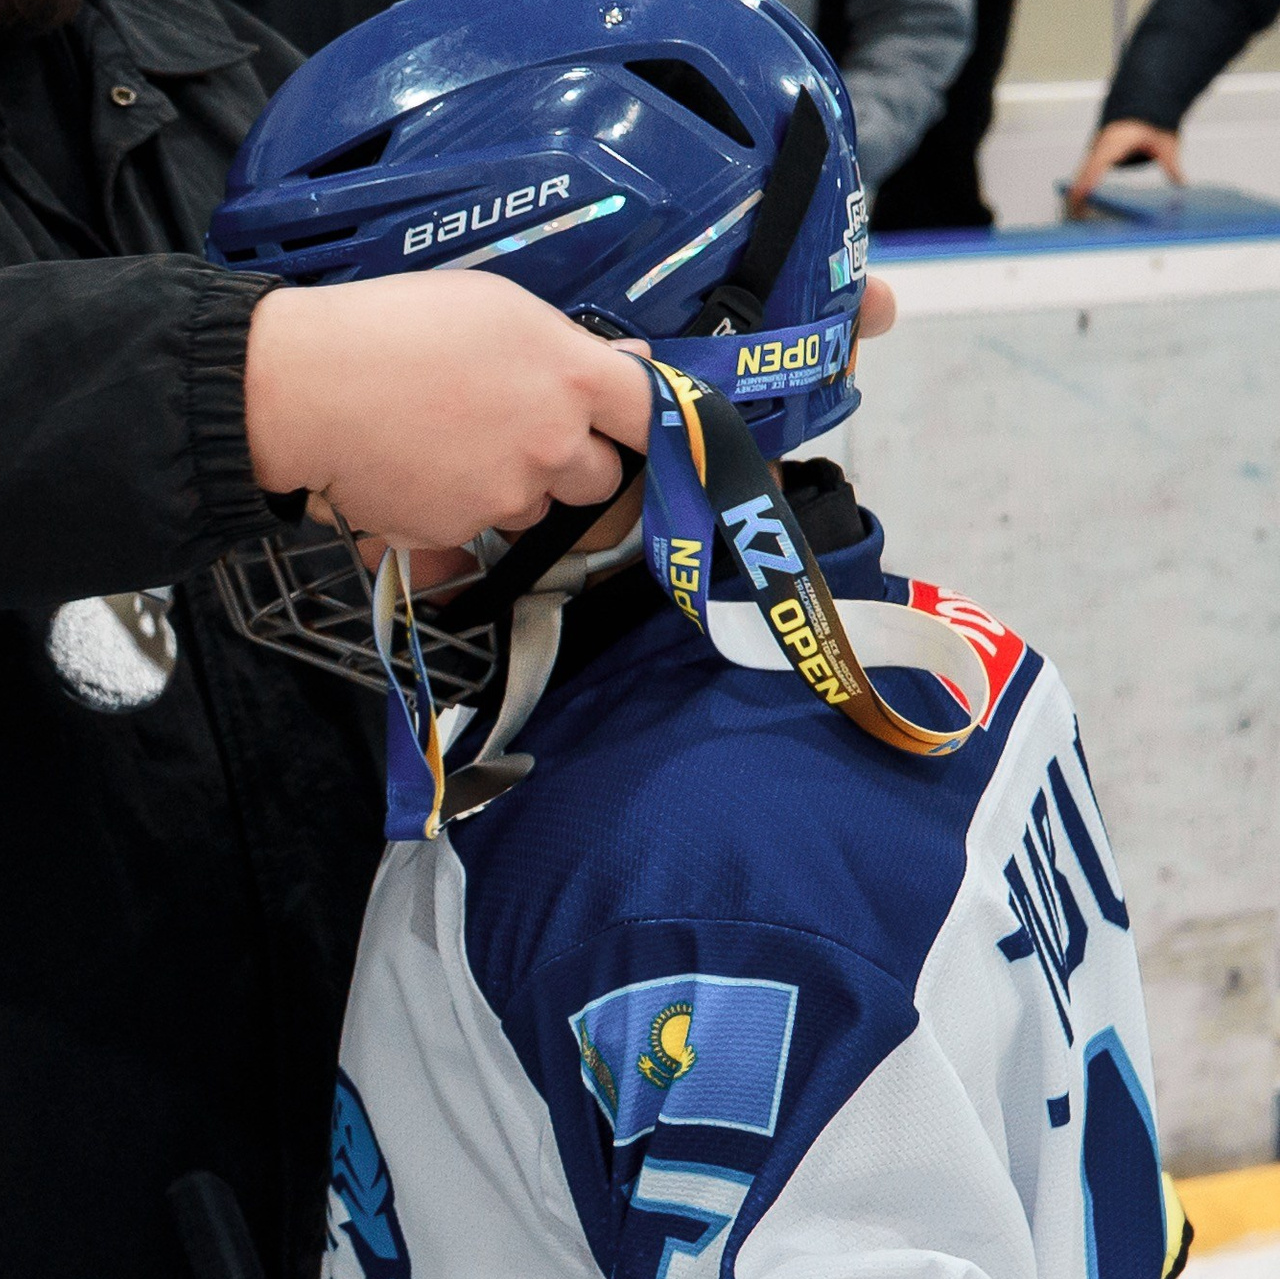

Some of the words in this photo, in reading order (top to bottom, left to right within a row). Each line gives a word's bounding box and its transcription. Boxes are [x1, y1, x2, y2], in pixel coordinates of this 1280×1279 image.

[402, 173, 570, 256] BAUER
[736, 333, 820, 376] OPEN
[720, 493, 805, 591] KZ
[770, 597, 851, 705] OPEN
